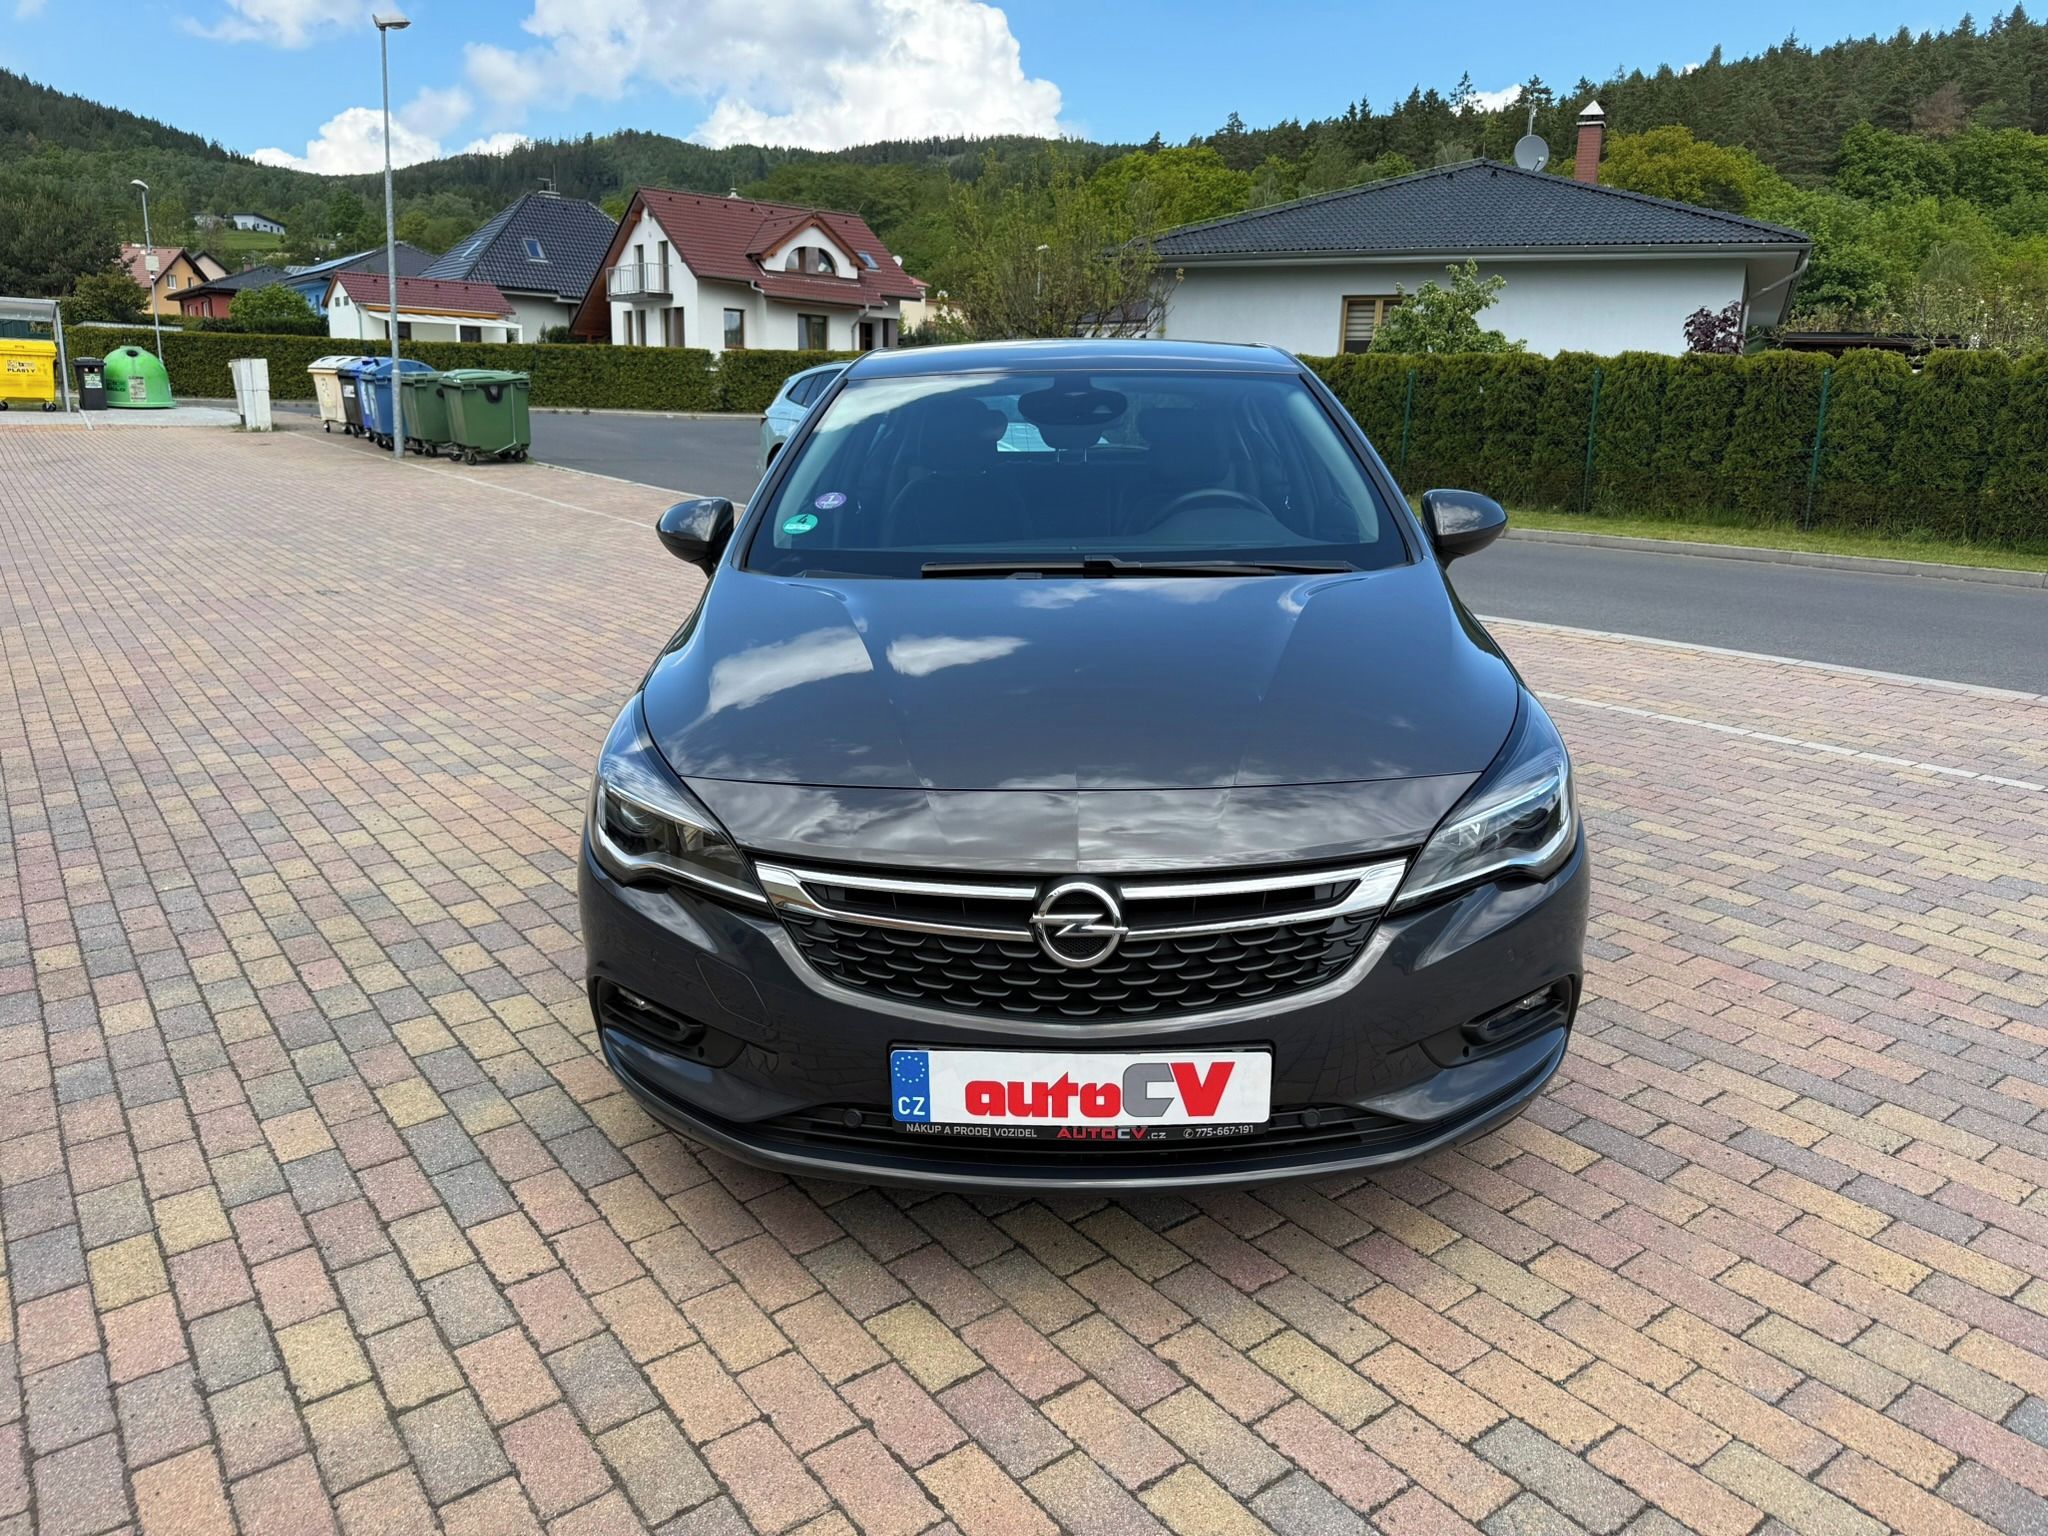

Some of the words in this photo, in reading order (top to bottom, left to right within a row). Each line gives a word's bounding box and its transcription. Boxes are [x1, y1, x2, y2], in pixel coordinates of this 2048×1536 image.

[964, 1061, 1236, 1118] autoCV
[897, 1095, 926, 1116] CZ
[906, 1122, 942, 1134] NÁKUP
[943, 1126, 952, 1135] A
[953, 1126, 992, 1138] PRODEJ
[993, 1127, 1038, 1138] VOZIDEL
[1195, 1124, 1254, 1138] 775-667-191
